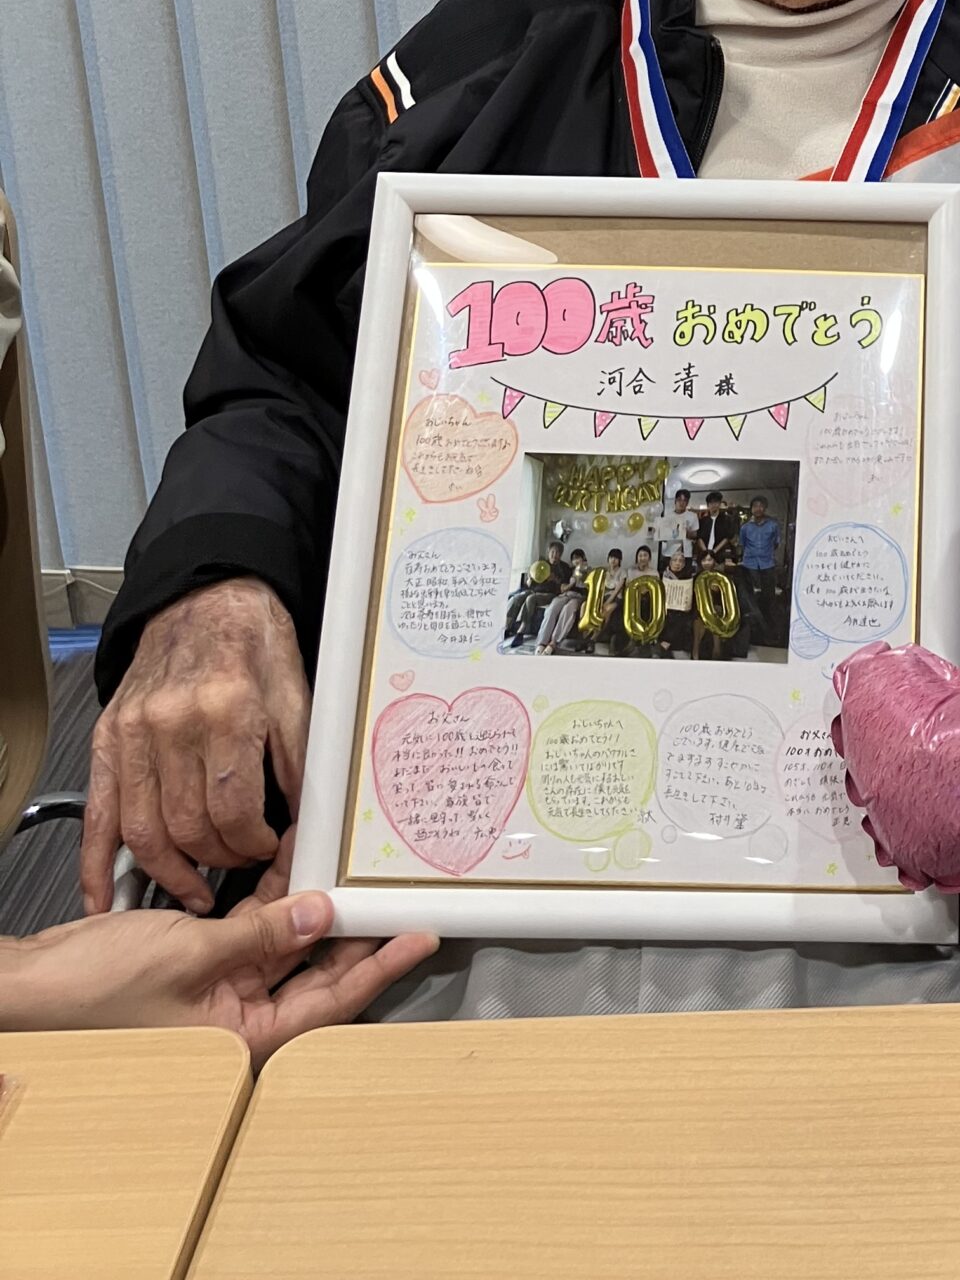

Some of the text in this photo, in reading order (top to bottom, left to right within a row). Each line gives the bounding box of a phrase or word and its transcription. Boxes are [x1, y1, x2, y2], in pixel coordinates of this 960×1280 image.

[446, 277, 884, 370] 100歳 おめでとう
[597, 362, 739, 398] 河合 清 様
